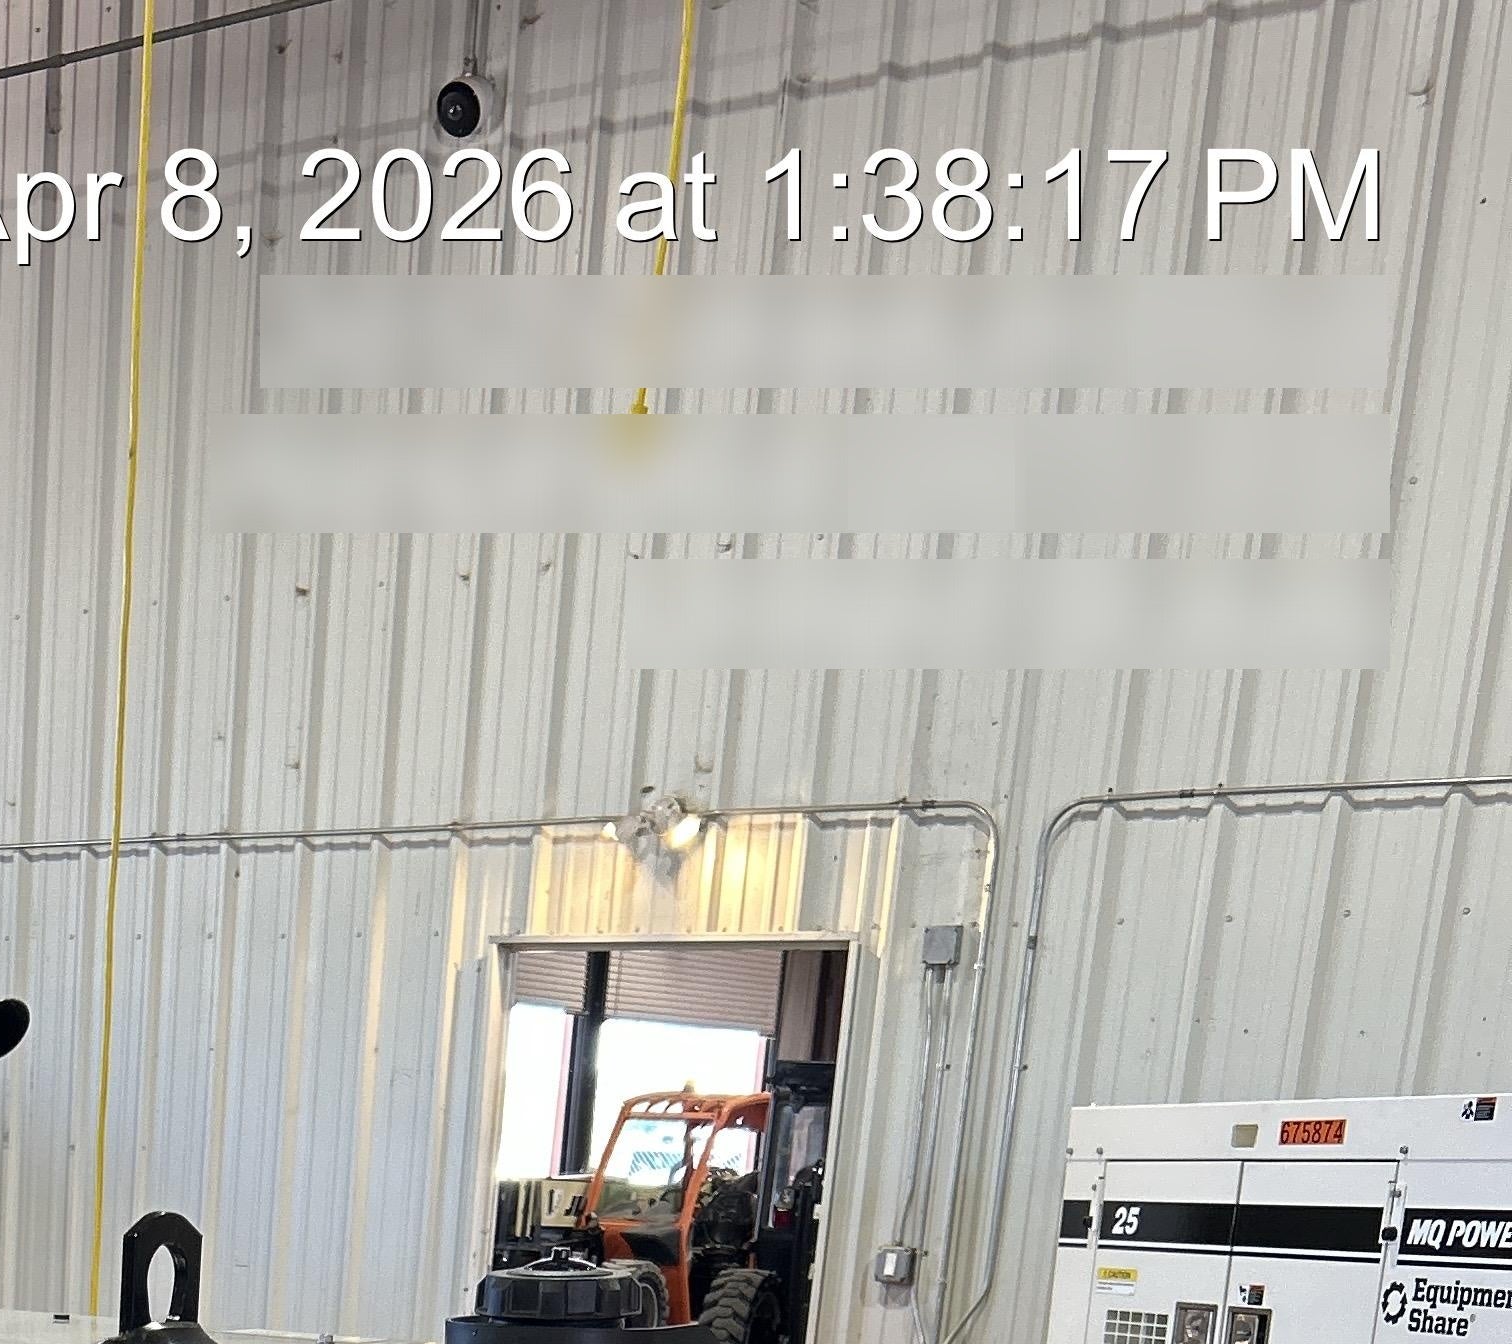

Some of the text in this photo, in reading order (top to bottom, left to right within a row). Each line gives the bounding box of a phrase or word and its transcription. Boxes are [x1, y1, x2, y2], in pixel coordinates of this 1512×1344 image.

[1280, 1120, 1345, 1145] 675874
[1111, 1206, 1140, 1235] 25
[1406, 1218, 1447, 1250] MQ
